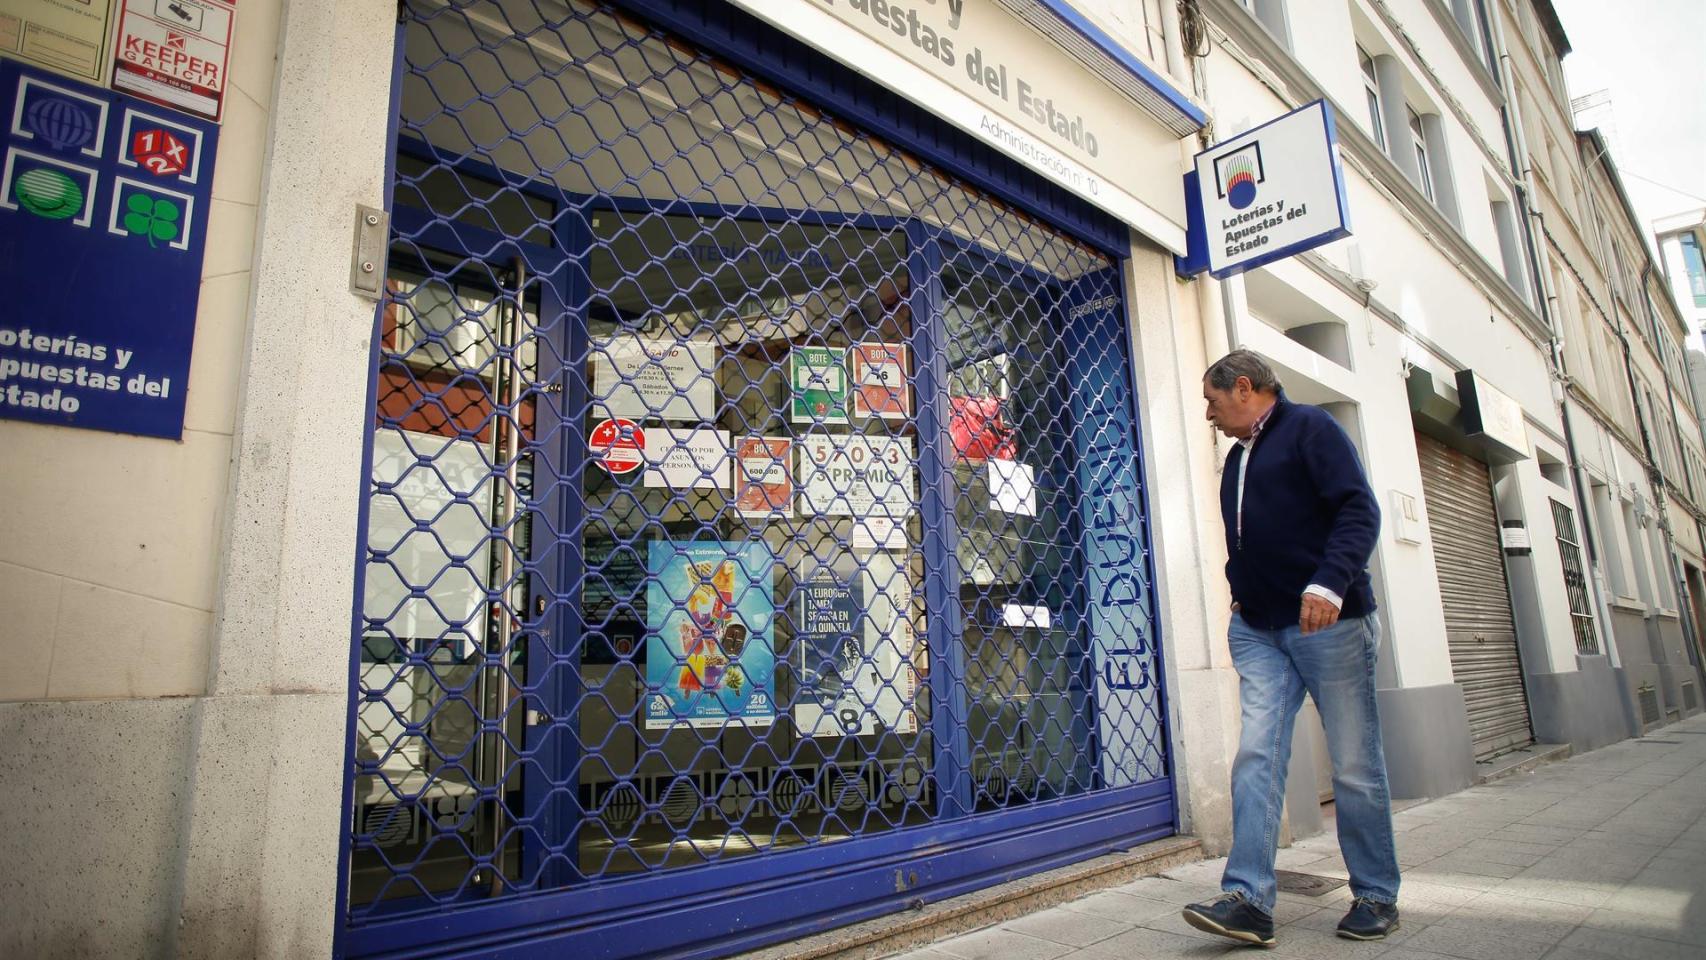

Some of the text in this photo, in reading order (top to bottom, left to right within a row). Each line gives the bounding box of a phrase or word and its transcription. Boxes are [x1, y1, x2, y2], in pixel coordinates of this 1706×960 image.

[125, 34, 218, 79] KEEPER
[123, 51, 218, 89] GALICIA
[823, 0, 1099, 158] uestas del Estado
[980, 114, 1071, 182] Administración
[1087, 177, 1098, 196] 10
[1222, 200, 1284, 230] Loterías y
[1225, 203, 1307, 244] Apuestas del
[1225, 235, 1269, 258] Estado
[115, 349, 133, 370] y
[809, 353, 827, 364] BOTE
[127, 374, 170, 398] del
[662, 462, 711, 470] PERSONES
[833, 468, 898, 483] PREMIO
[818, 622, 851, 633] QUINELA
[839, 611, 849, 621] EN
[750, 694, 767, 705] 20
